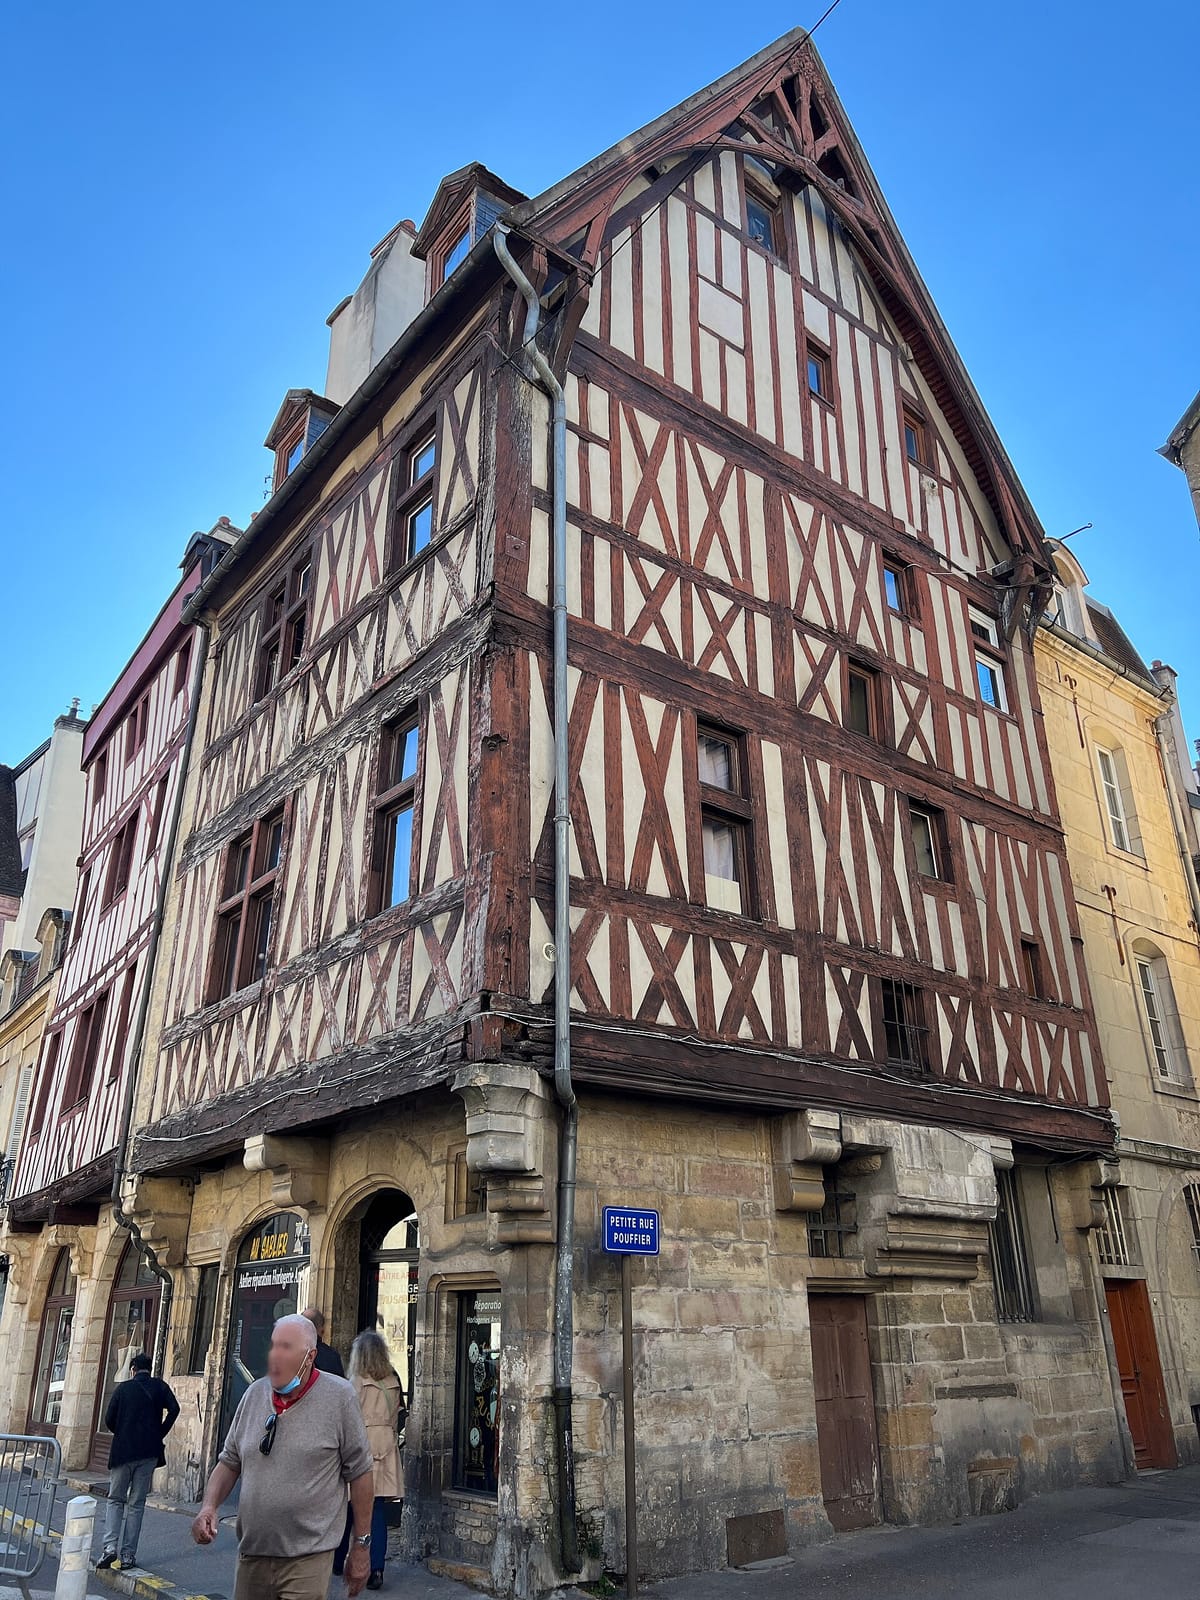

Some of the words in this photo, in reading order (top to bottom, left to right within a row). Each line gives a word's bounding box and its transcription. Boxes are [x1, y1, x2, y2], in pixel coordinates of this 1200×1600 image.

[610, 1215, 637, 1228] PETITE
[639, 1218, 654, 1229] RUE
[613, 1232, 651, 1245] POUFFIER
[250, 1237, 260, 1260] AU
[261, 1232, 289, 1260] SABLIER
